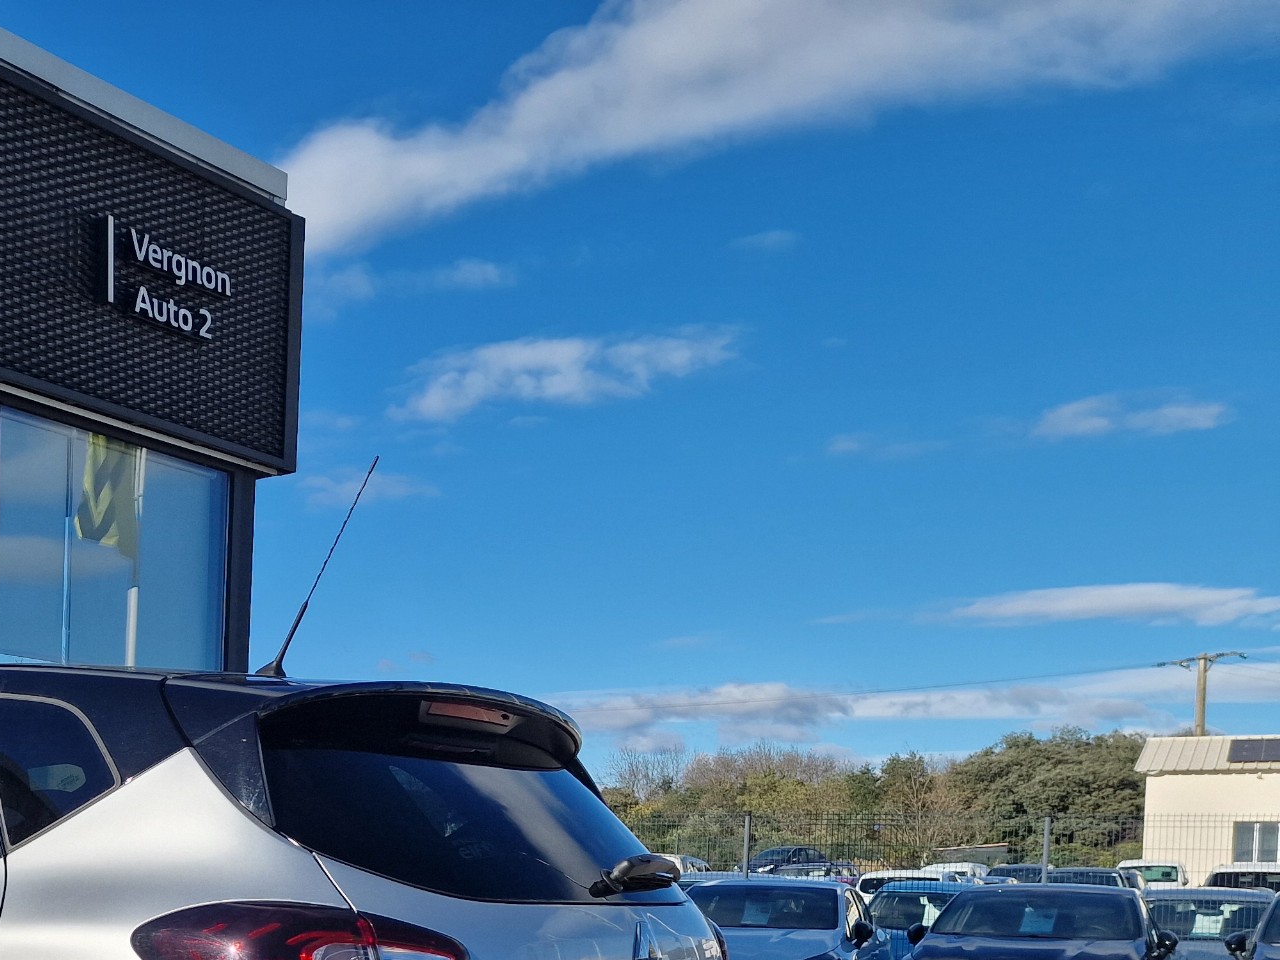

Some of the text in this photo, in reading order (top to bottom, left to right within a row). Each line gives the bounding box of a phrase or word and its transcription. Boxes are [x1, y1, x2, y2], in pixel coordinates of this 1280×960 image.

[130, 227, 232, 297] Vergnon
[134, 285, 213, 340] Auto 2
